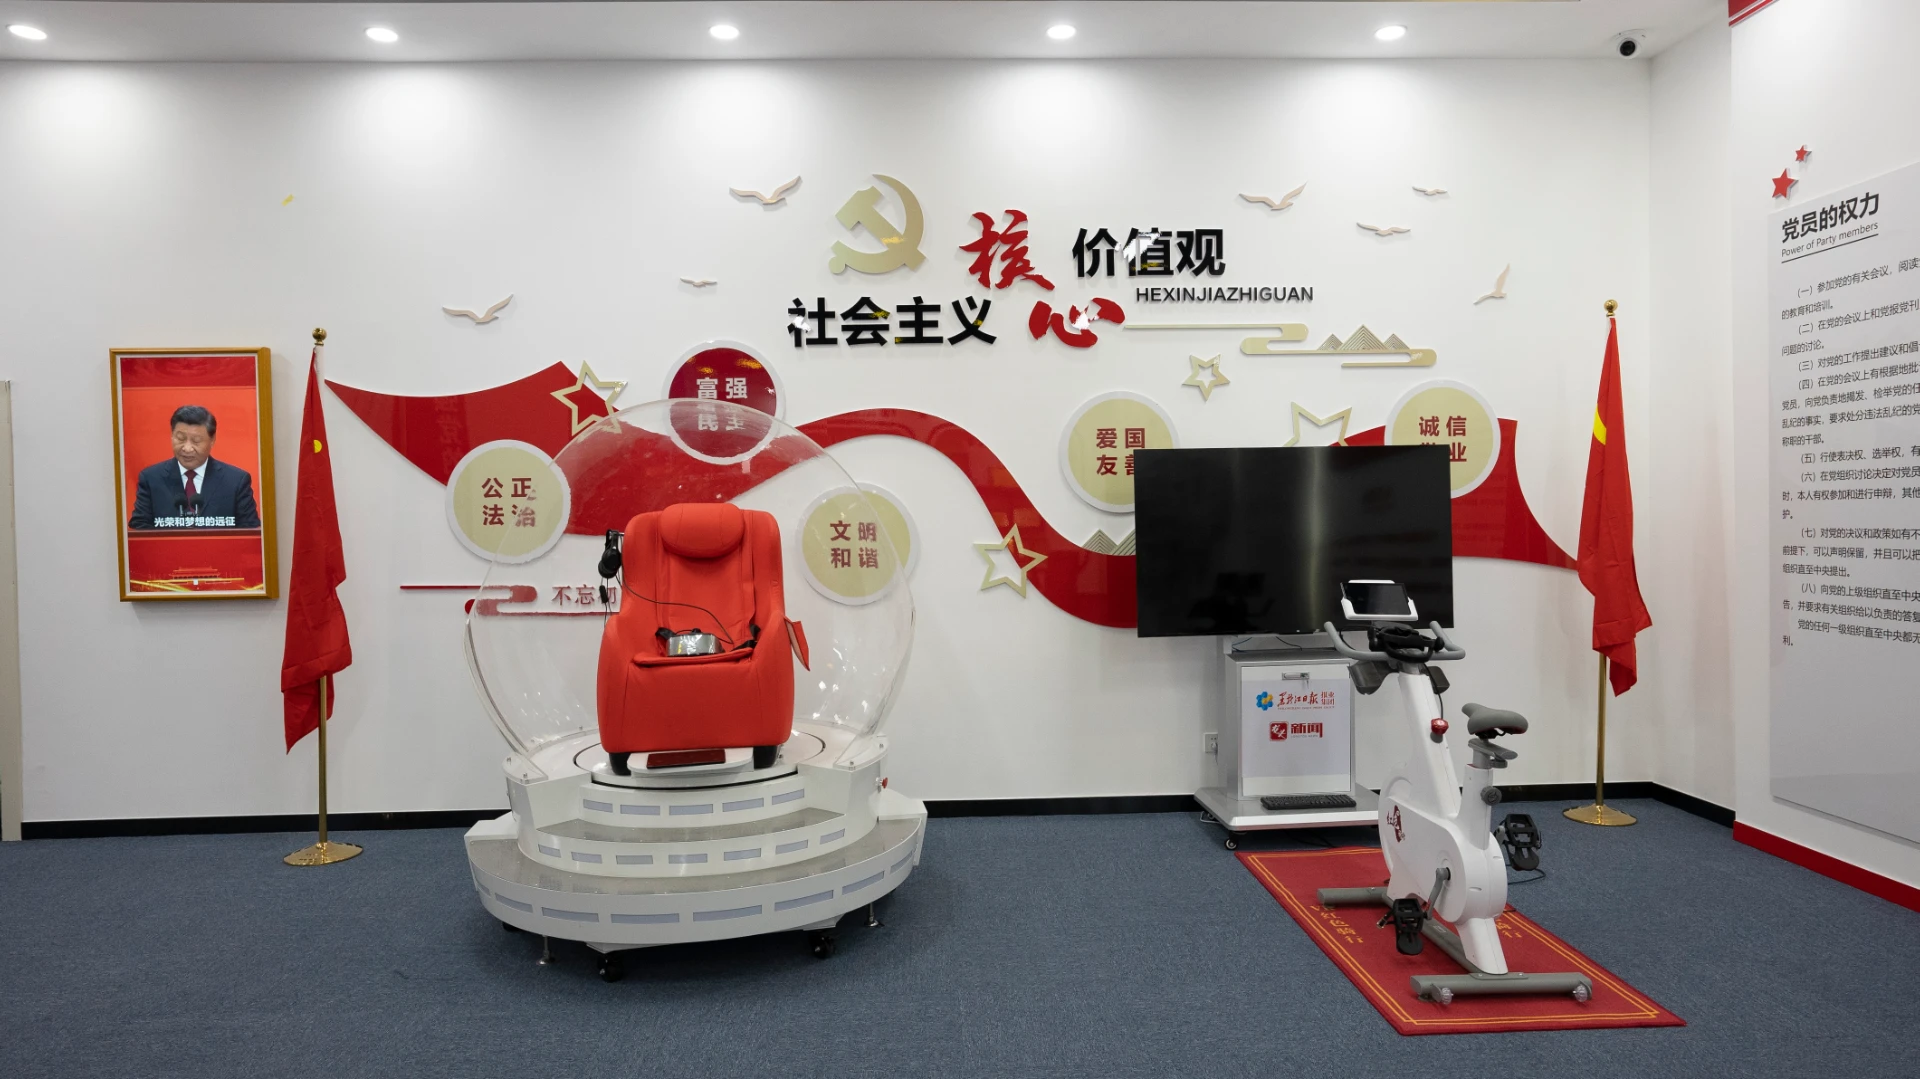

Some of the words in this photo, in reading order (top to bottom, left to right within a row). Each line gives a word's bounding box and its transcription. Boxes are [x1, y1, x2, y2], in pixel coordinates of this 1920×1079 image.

[1782, 192, 1879, 244] 党员的权力
[1781, 243, 1804, 257] Power
[1806, 239, 1815, 250] of
[1816, 234, 1837, 247] Party
[1838, 222, 1878, 241] members
[1072, 227, 1225, 278] 价值观
[1797, 257, 1920, 298] （一）参加党的有关会议，阅读
[1136, 286, 1314, 304] HEXINJIAZHIGUAN
[787, 295, 997, 348] 社会主义
[1798, 341, 1920, 372] （三）对党的工作提出建议和倡
[1798, 362, 1920, 390] （四）在党的会议上有根据地批
[696, 377, 748, 399] 富强
[1418, 415, 1467, 437] 诚信
[1096, 427, 1146, 449] 爱国
[482, 477, 535, 499] 公正
[153, 516, 236, 528] 光荣和梦想的远征
[482, 504, 536, 528] 法治
[830, 520, 877, 543] 文明
[830, 547, 879, 569] 和谐
[1291, 722, 1323, 738] 新闻
